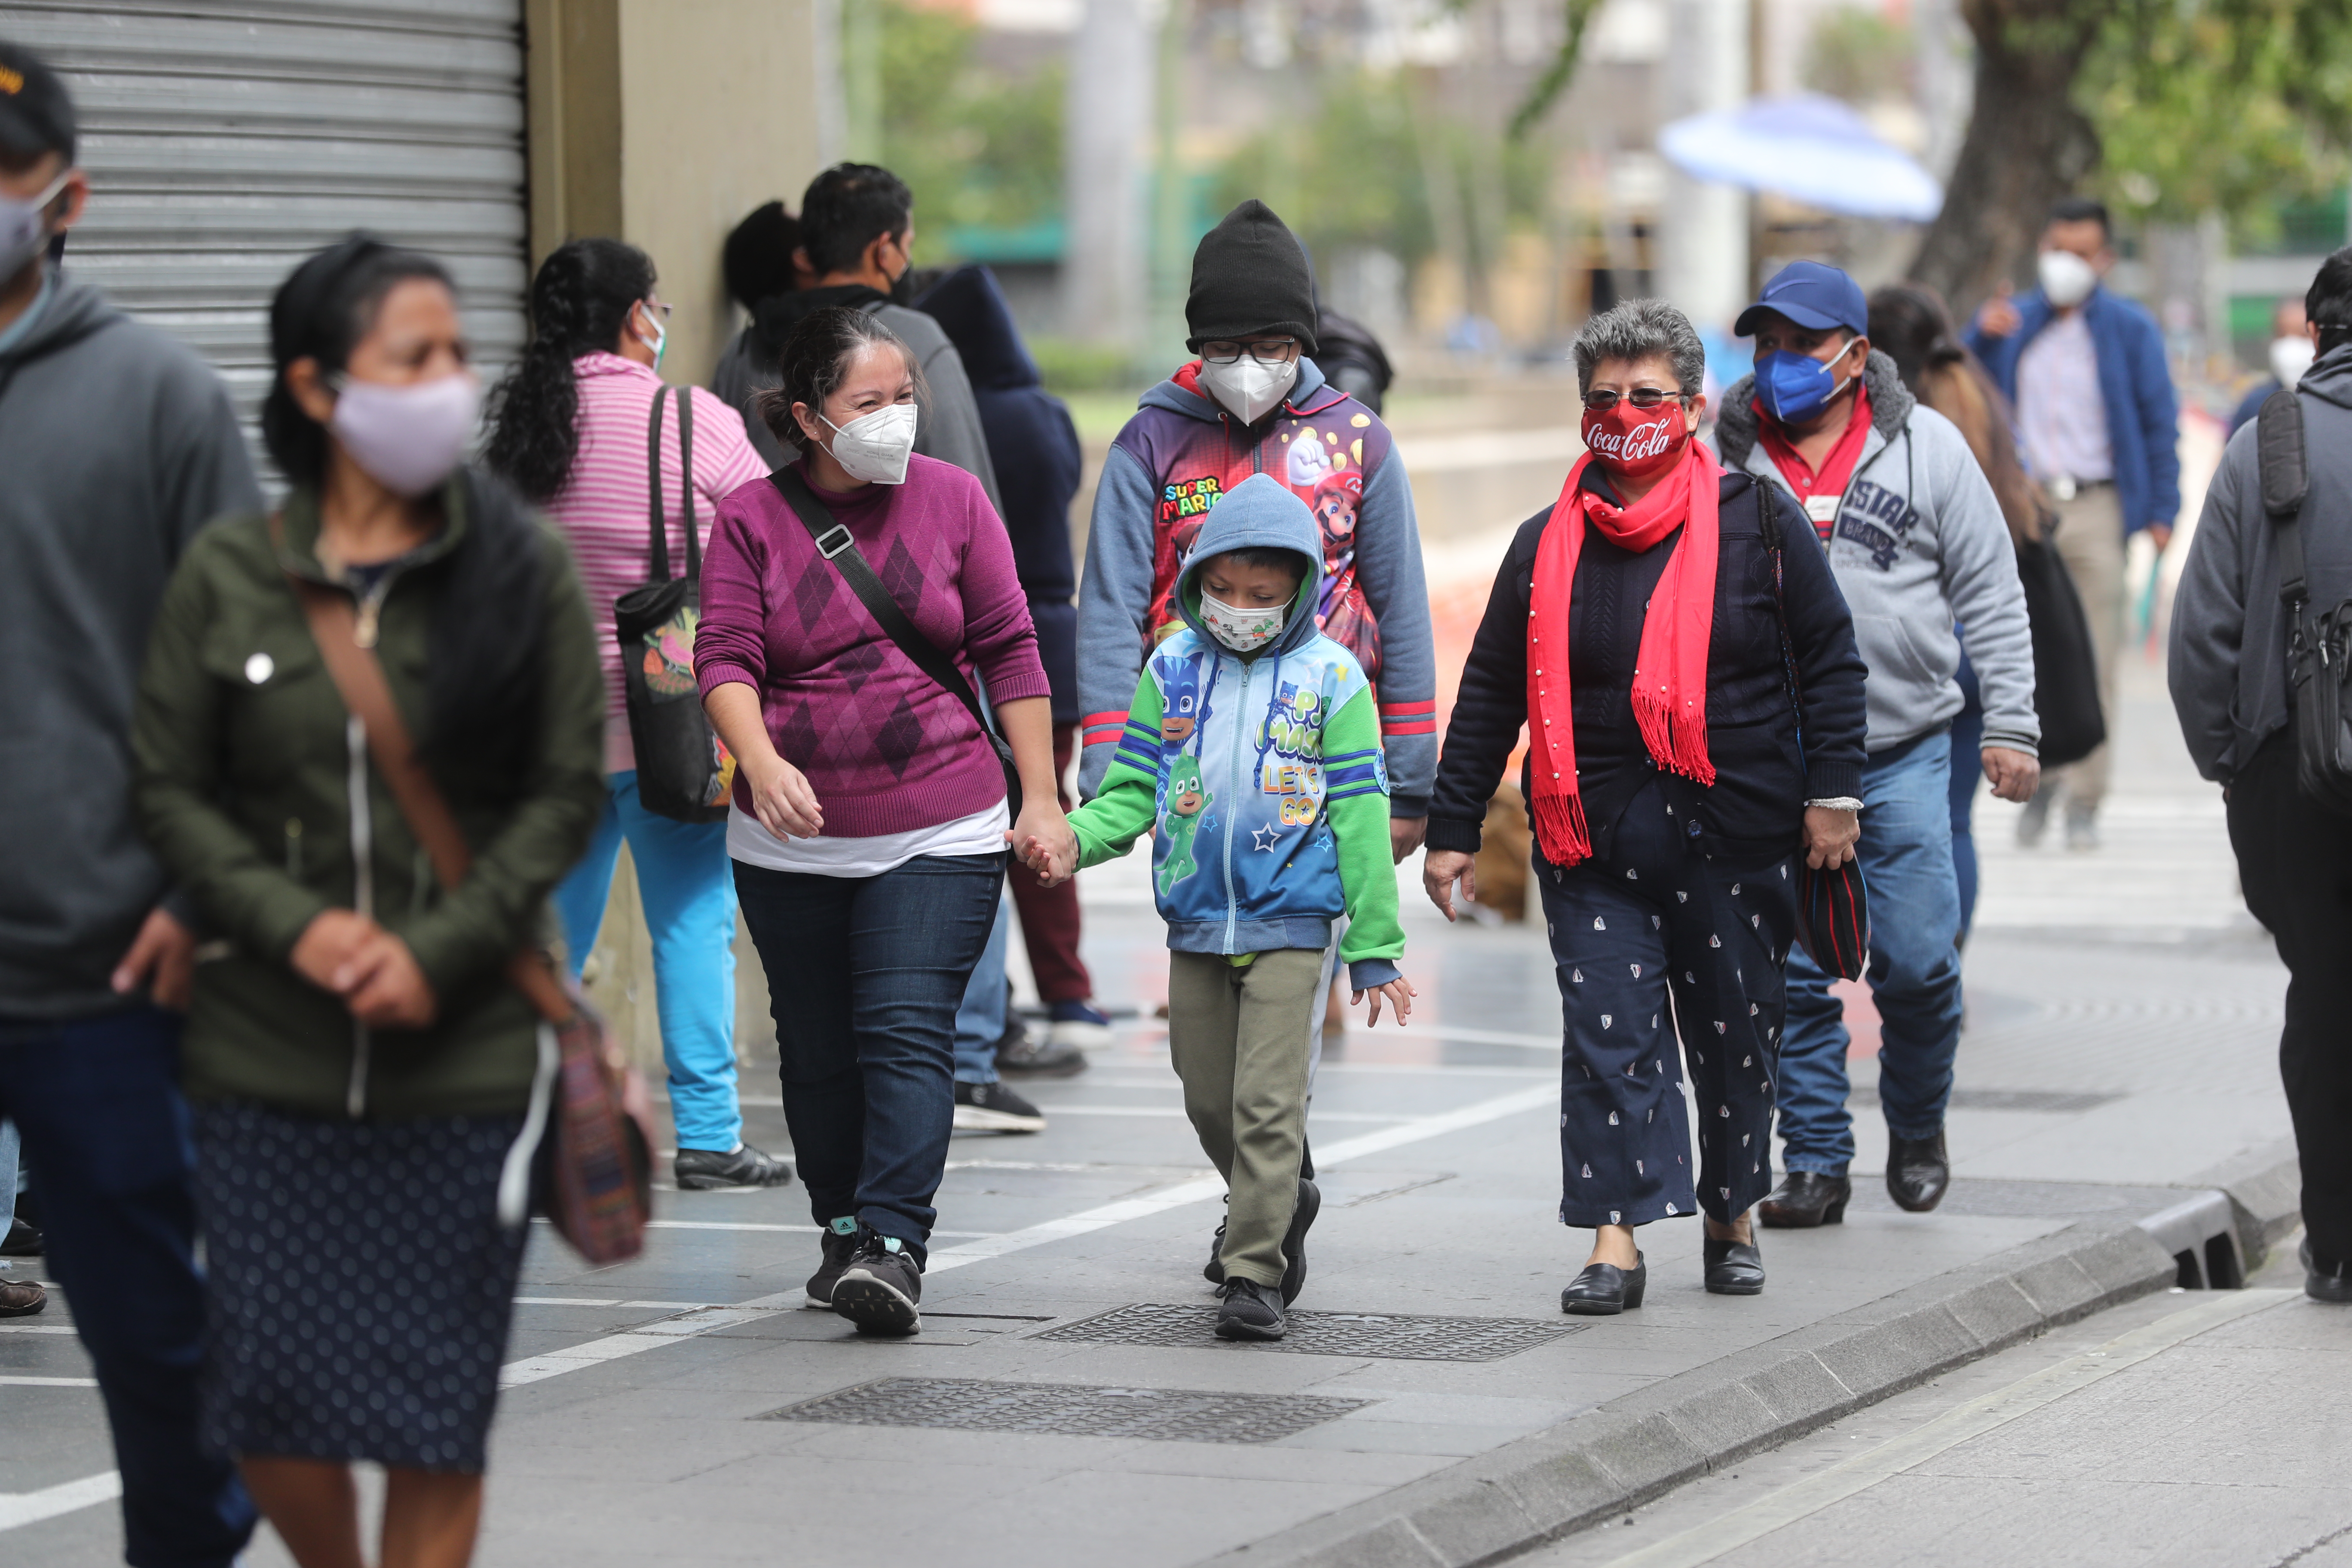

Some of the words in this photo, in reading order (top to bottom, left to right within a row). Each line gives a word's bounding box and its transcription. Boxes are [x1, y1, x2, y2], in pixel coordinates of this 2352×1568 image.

[1587, 416, 1671, 461] Coca-Cola
[1165, 478, 1218, 501] SUPER
[1263, 764, 1318, 793] LET'S
